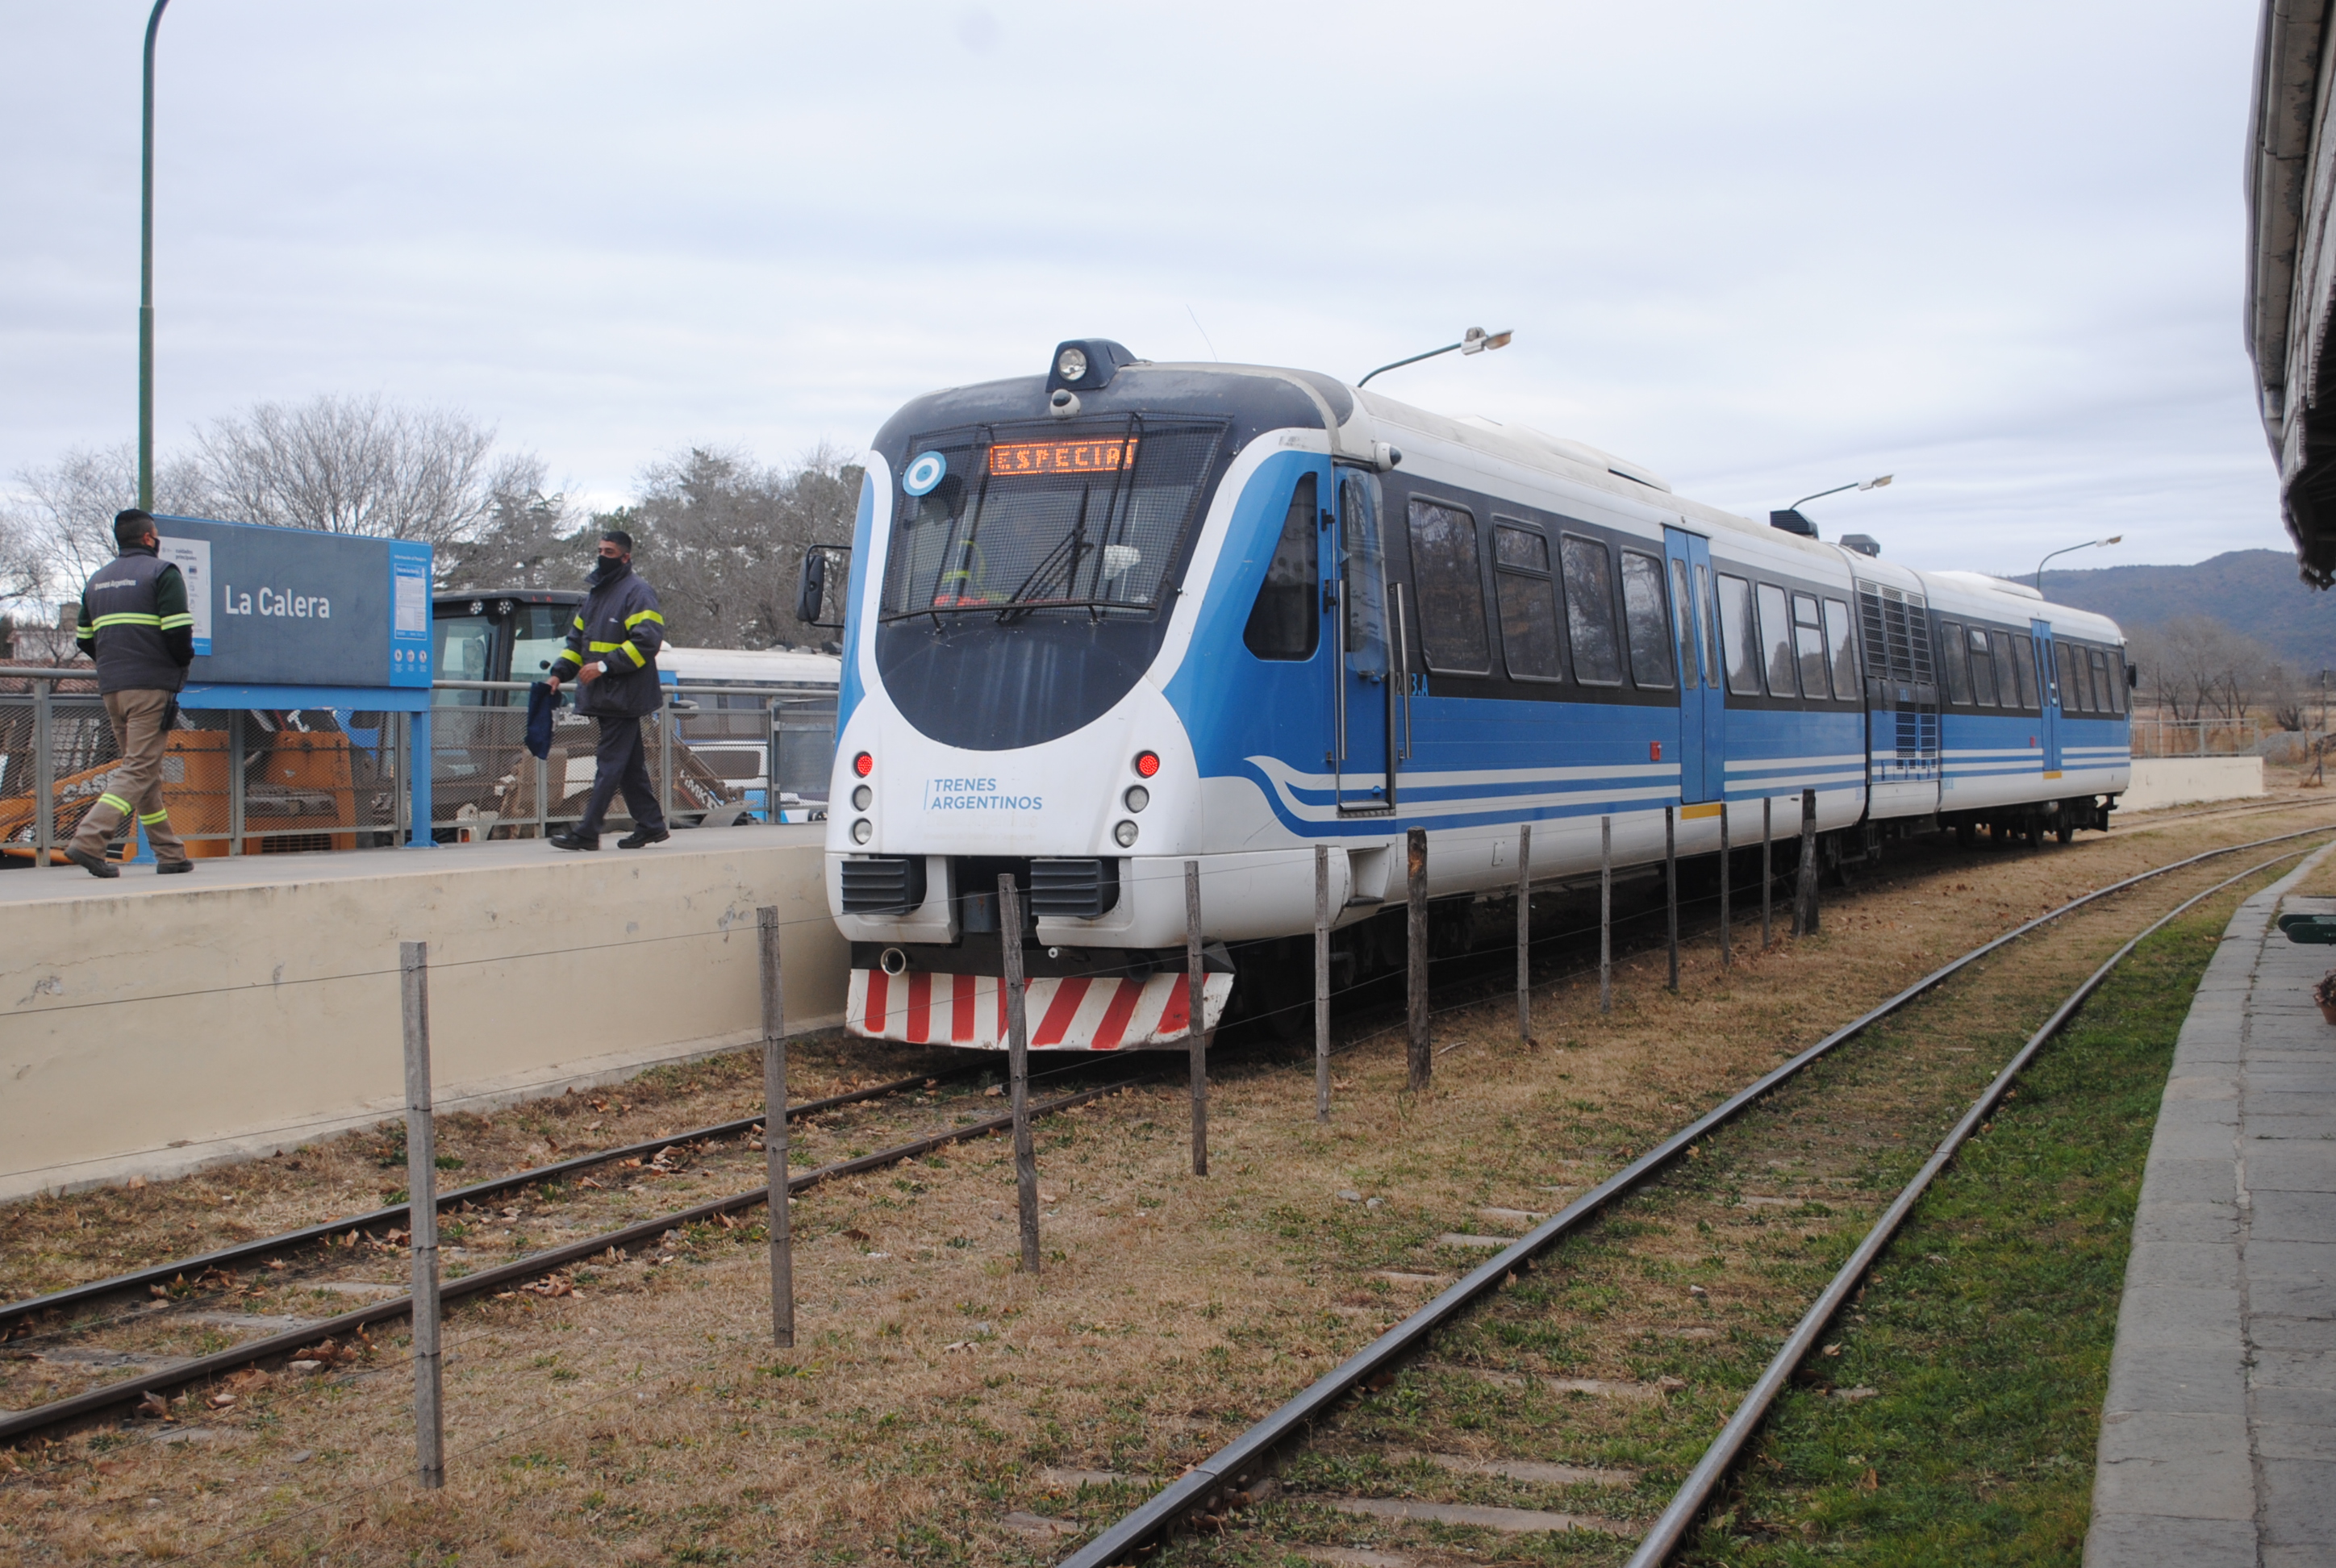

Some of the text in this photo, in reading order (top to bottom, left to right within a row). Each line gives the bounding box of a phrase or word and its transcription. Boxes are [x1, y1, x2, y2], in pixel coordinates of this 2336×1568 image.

[225, 585, 330, 619] La Calera
[934, 778, 996, 792] TRENES
[931, 796, 1042, 810] ARGENTINOS
